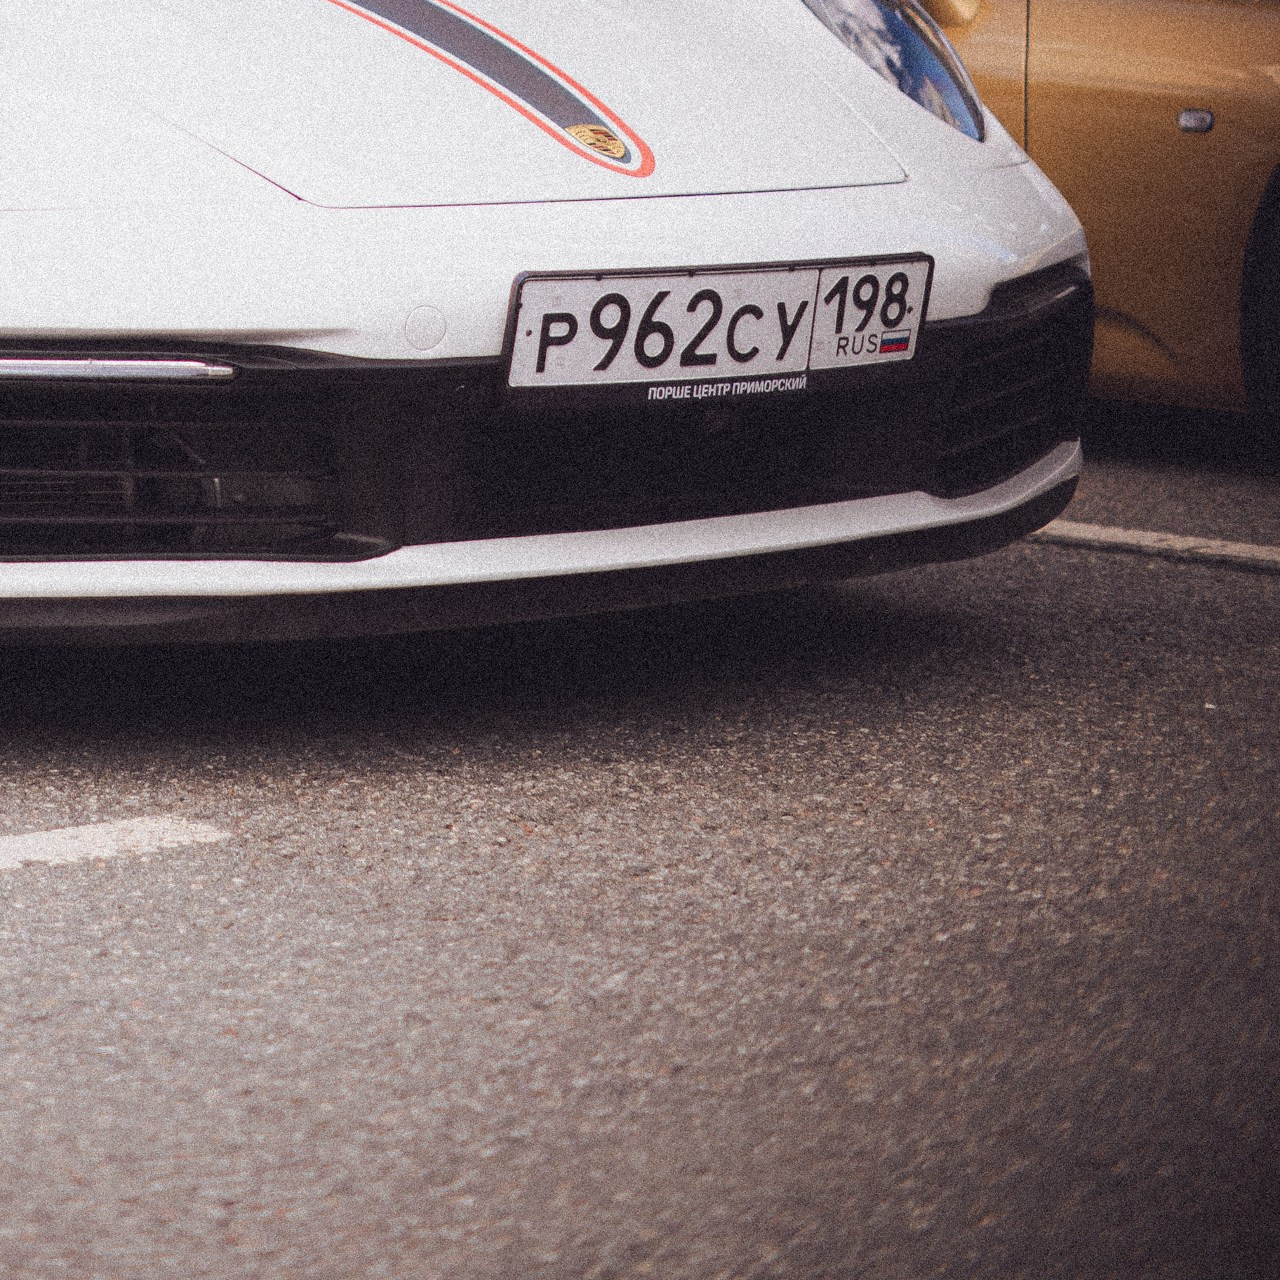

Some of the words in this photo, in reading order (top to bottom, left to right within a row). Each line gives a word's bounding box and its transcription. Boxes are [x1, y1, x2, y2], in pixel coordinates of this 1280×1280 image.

[823, 272, 909, 333] 198
[836, 333, 878, 356] RUS
[648, 385, 692, 401] ПОРШЕ
[692, 382, 731, 400] ЦЕНТР
[731, 375, 808, 396] ПРИМОРСКИЙ
